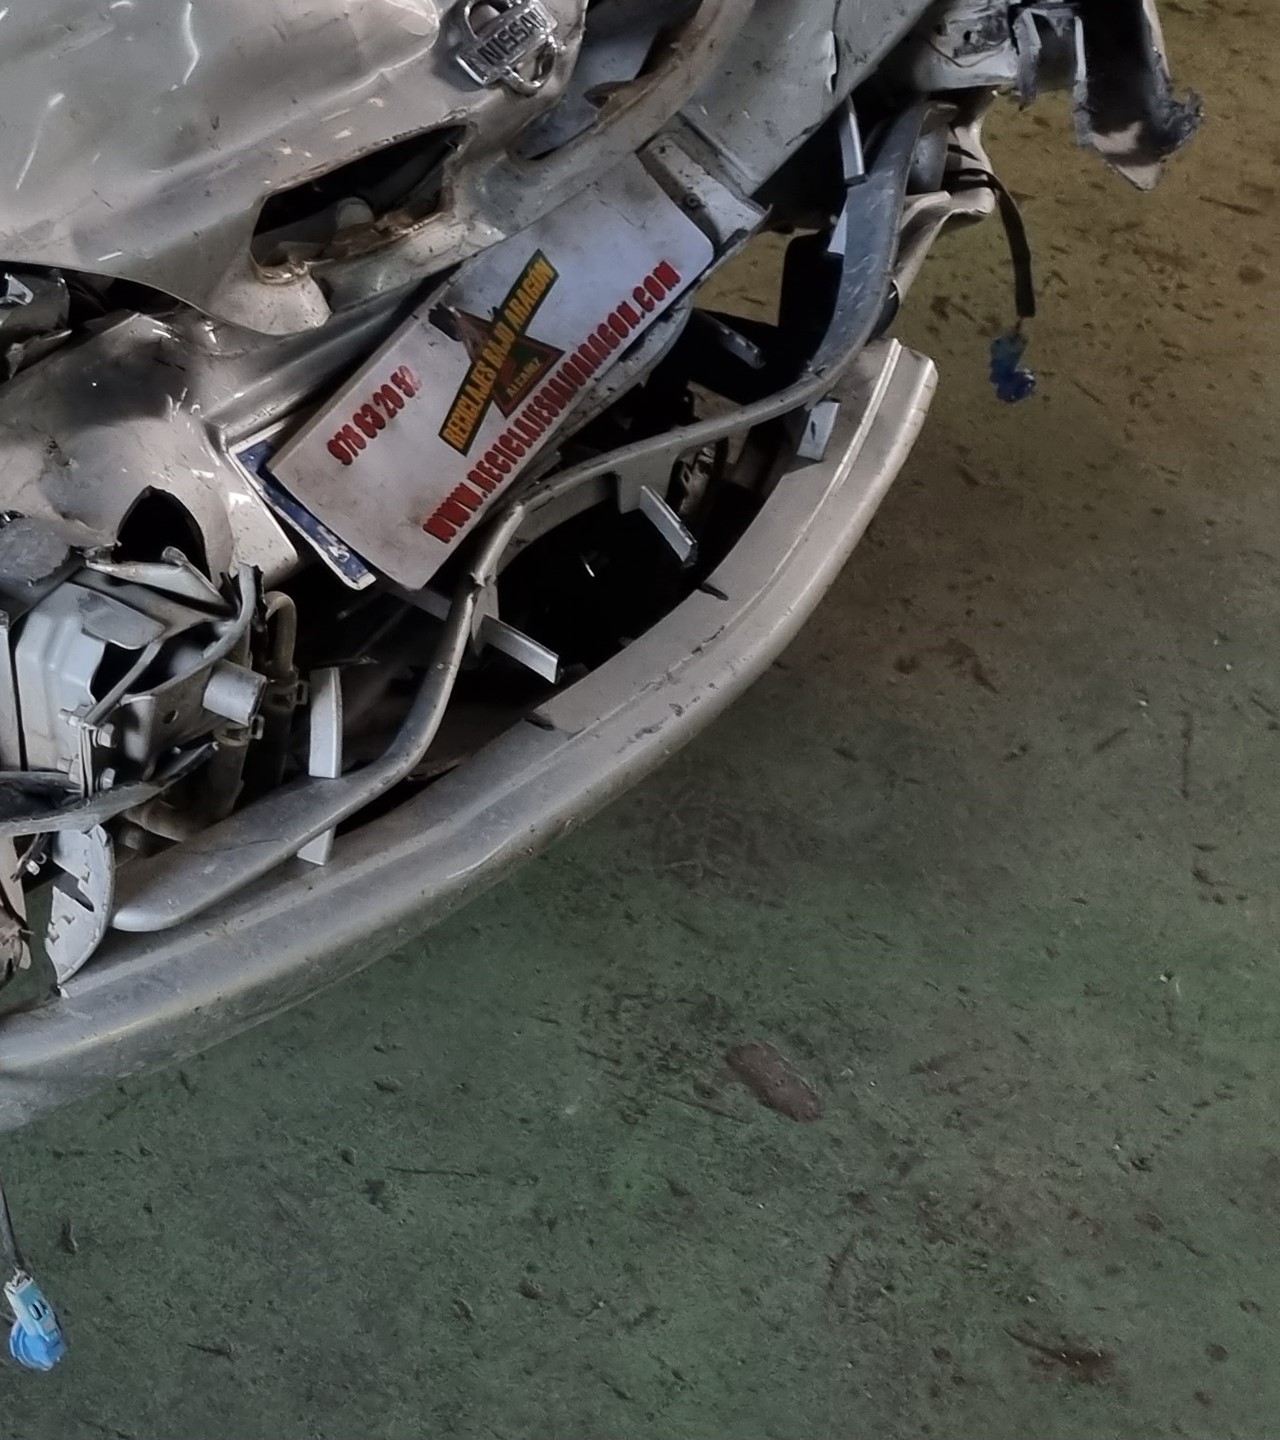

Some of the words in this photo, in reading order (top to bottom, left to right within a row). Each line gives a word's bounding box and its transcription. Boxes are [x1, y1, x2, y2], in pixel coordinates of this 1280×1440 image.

[476, 10, 546, 65] NISSAN
[327, 424, 366, 466] 978
[373, 384, 405, 419] 20
[422, 260, 681, 544] WWW.RECICLAJESBAJOARAGON.COM
[442, 361, 496, 449] RECICLAJES
[482, 321, 516, 369] BAJO
